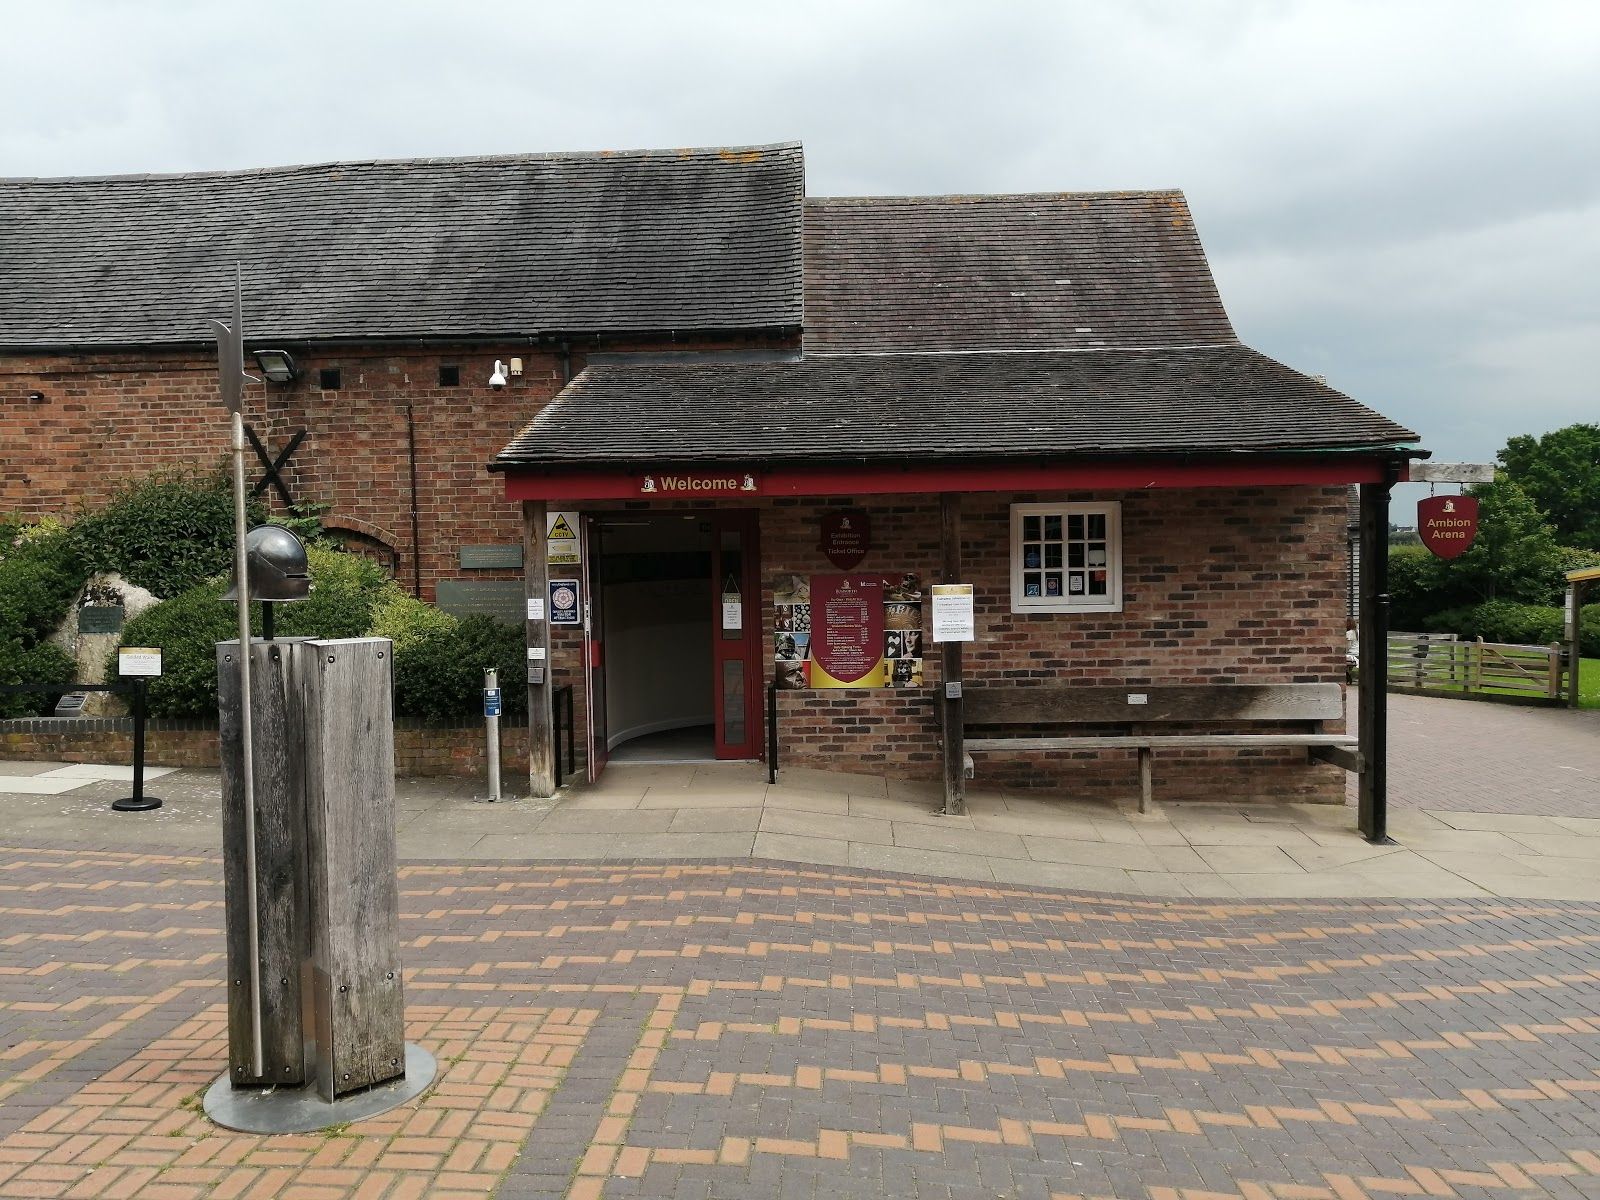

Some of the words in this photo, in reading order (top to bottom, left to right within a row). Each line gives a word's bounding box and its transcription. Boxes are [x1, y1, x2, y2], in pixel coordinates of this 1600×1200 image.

[660, 476, 738, 491] Welcome
[1426, 518, 1471, 528] Ambion
[1431, 530, 1466, 539] Arena
